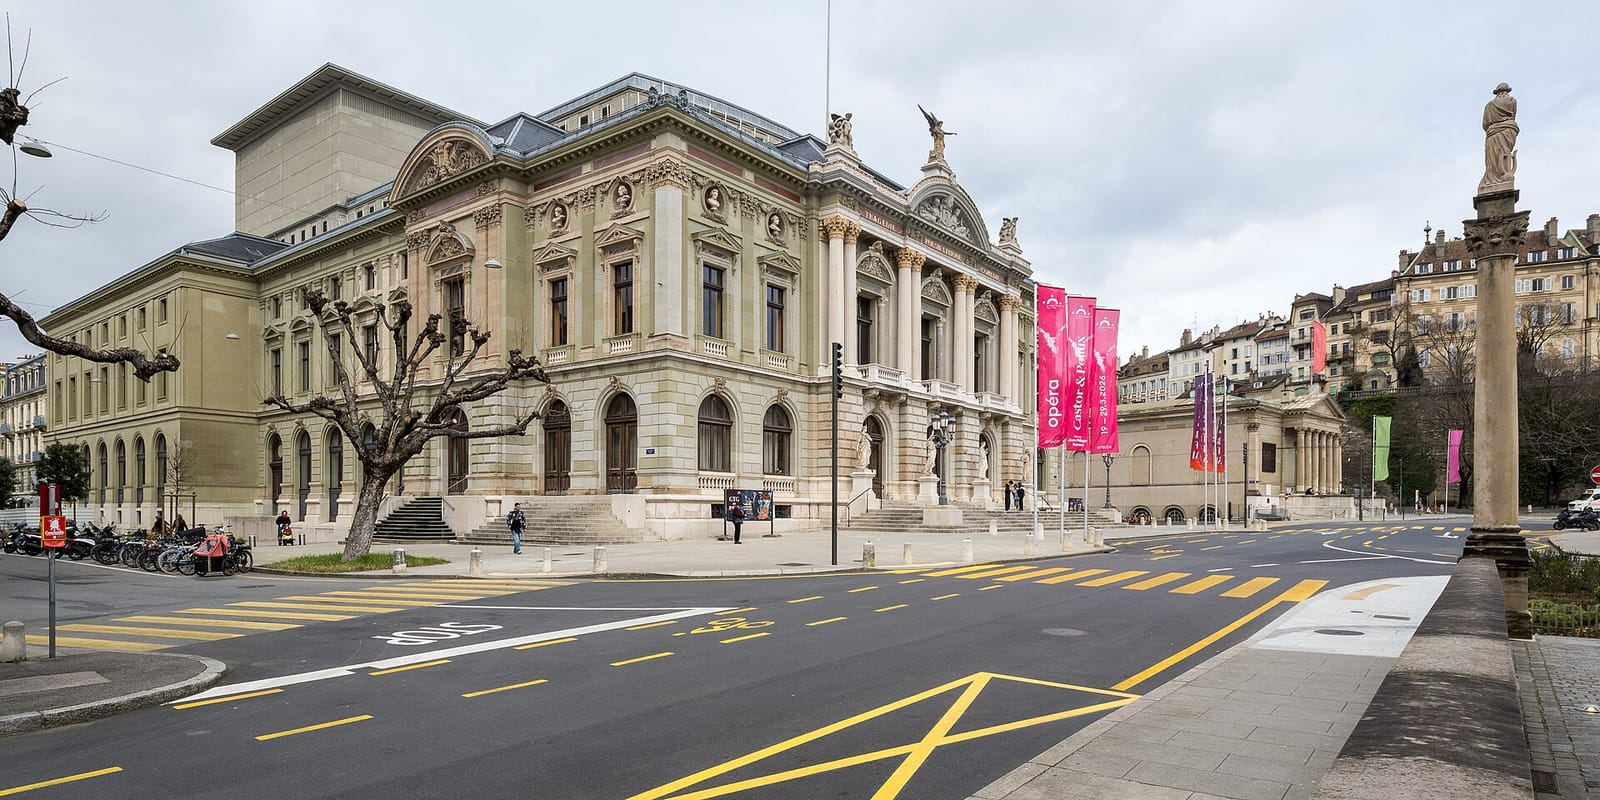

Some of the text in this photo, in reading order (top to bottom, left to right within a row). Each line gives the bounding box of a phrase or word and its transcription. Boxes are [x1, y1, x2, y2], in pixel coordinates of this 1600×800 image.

[1076, 376, 1086, 387] &
[1045, 379, 1062, 428] opéra
[1072, 388, 1084, 431] Castor
[1100, 425, 1109, 435] 19
[371, 622, 503, 645] STOP
